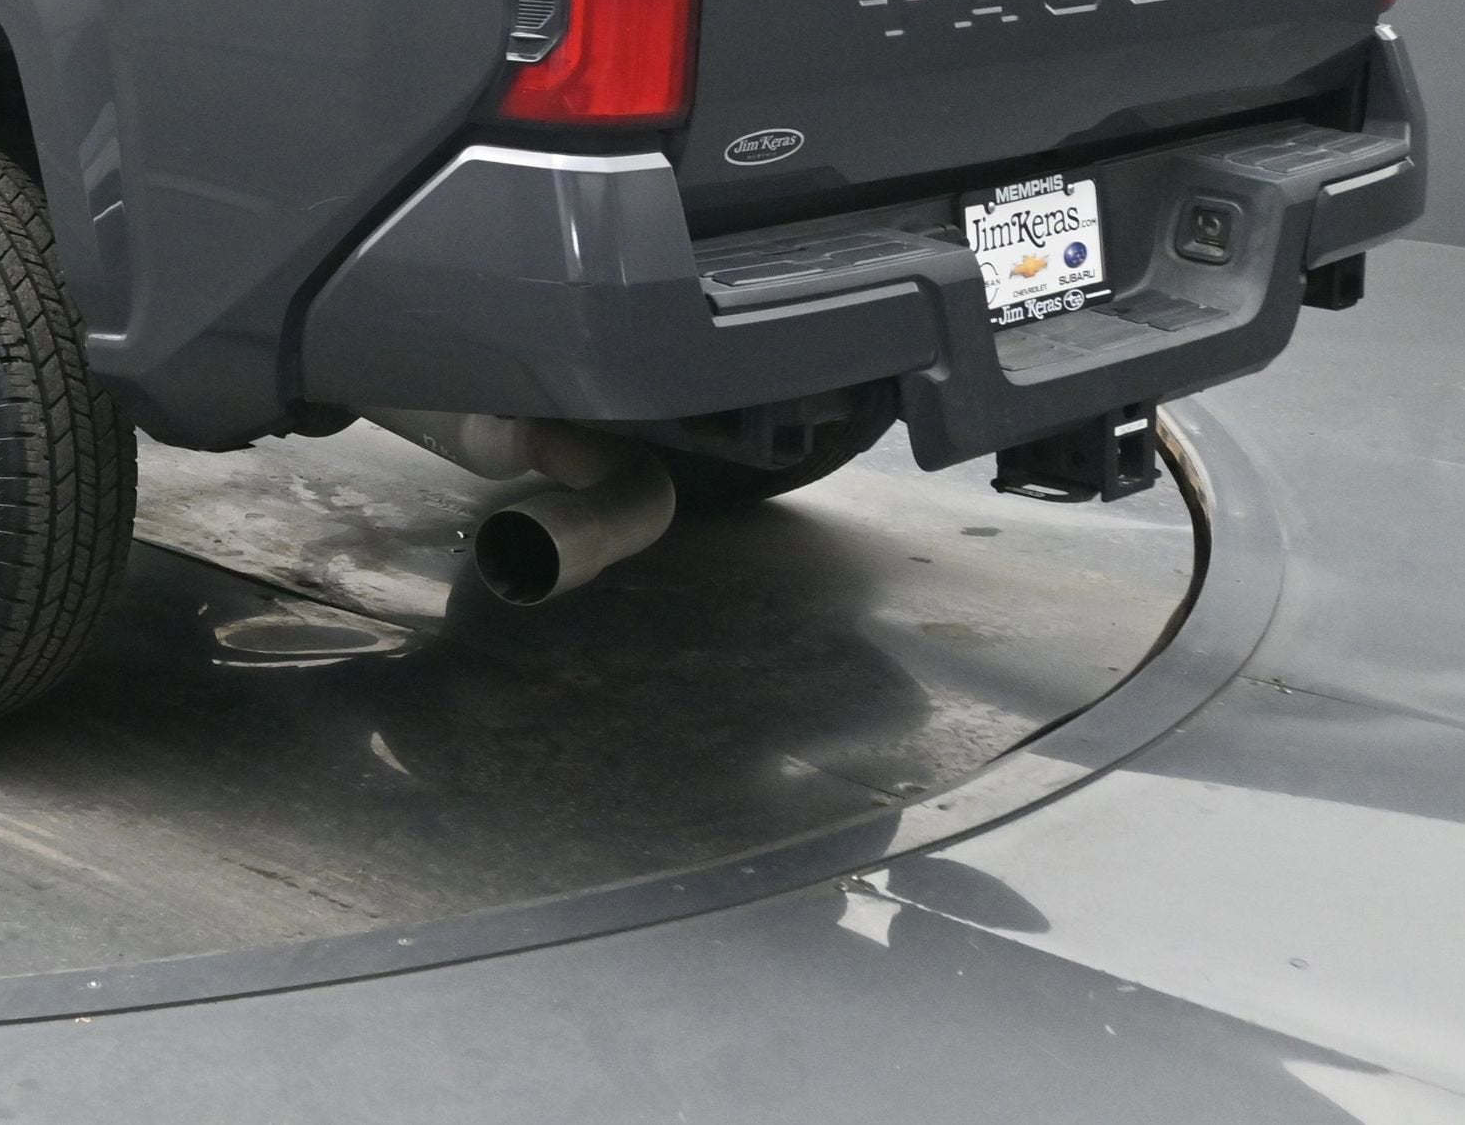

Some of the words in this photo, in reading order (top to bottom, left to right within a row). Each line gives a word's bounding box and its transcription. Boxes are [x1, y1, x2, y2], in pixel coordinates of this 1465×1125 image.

[995, 174, 1064, 204] MEMPHIS
[1058, 269, 1096, 286] SUBARU
[1012, 283, 1048, 299] CHEVROLET
[998, 305, 1025, 325] Jim
[1024, 296, 1063, 320] Keras
